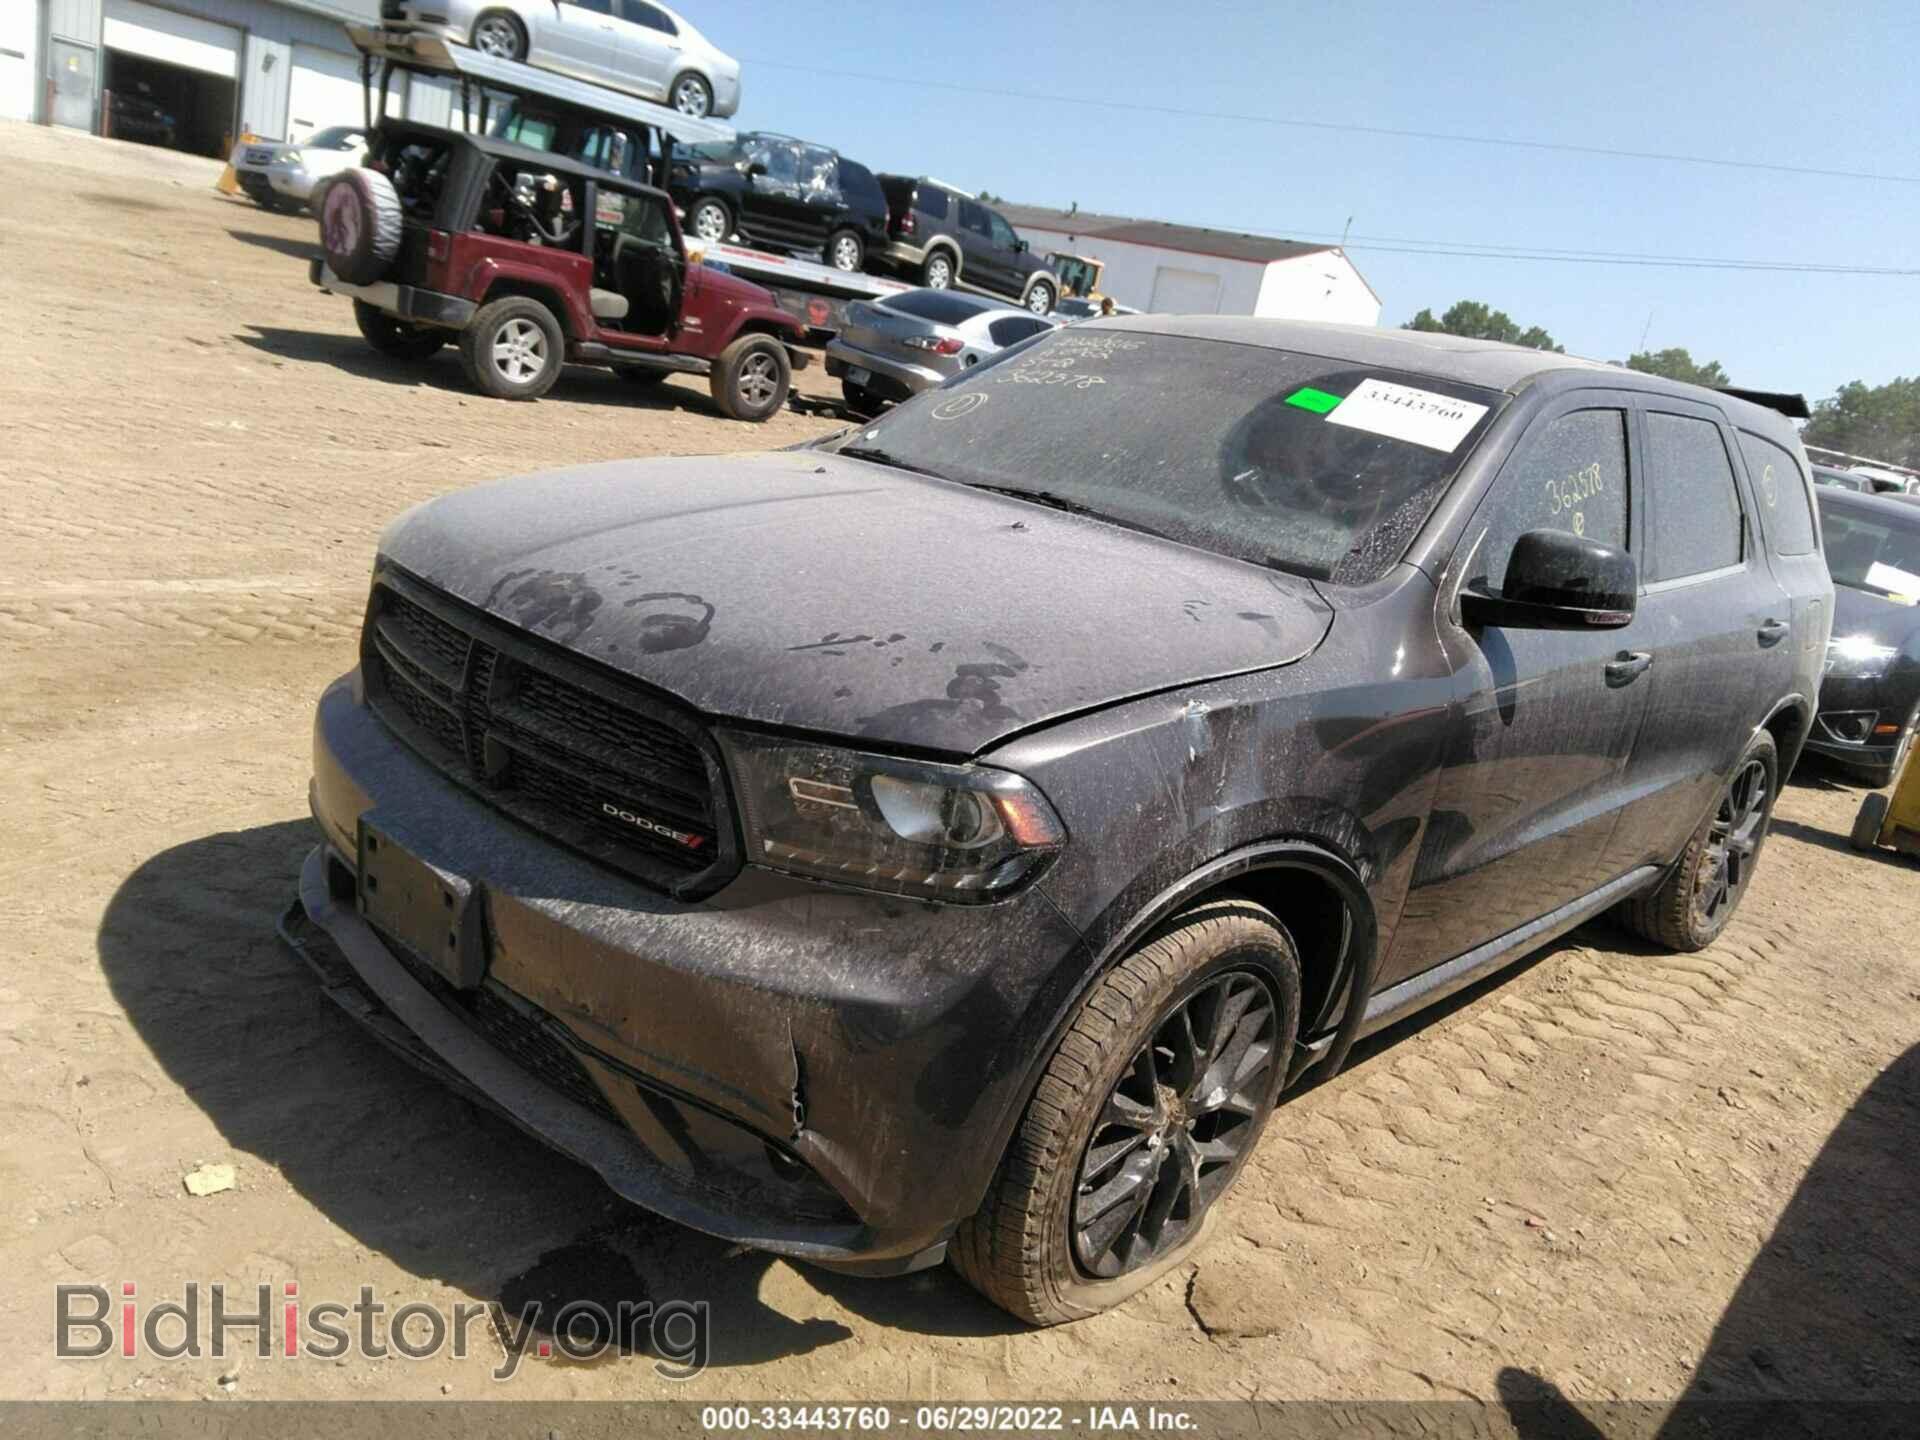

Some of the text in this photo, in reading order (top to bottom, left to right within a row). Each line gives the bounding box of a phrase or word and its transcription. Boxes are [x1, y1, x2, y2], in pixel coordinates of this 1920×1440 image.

[1363, 389, 1464, 420] 33443760
[1545, 462, 1603, 515] 362578
[602, 802, 690, 845] DODGE
